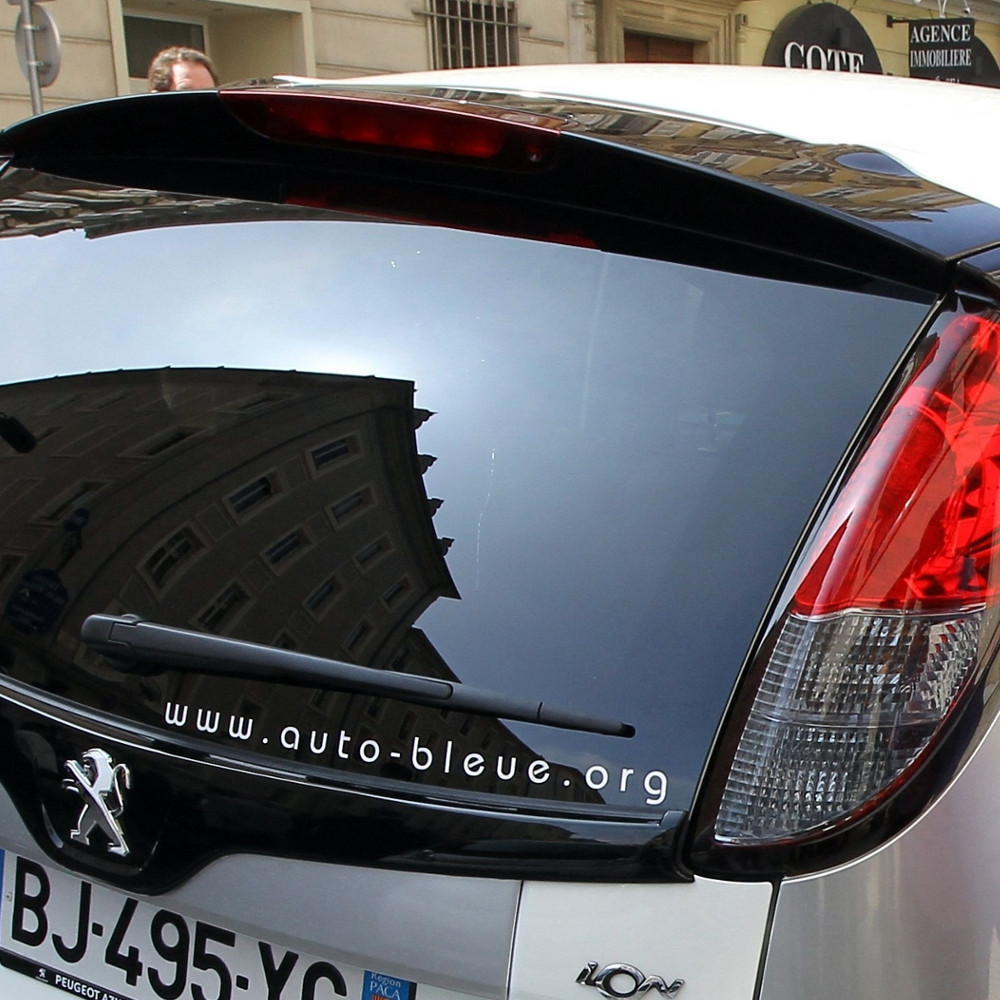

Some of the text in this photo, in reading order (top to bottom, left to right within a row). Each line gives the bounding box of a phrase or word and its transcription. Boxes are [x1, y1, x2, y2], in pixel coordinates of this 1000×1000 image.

[910, 24, 972, 43] AGENCE
[910, 49, 972, 68] IMMOBILIERE
[163, 700, 669, 805] www.auto-bleue.org
[55, 974, 101, 1000] PEUGEOT
